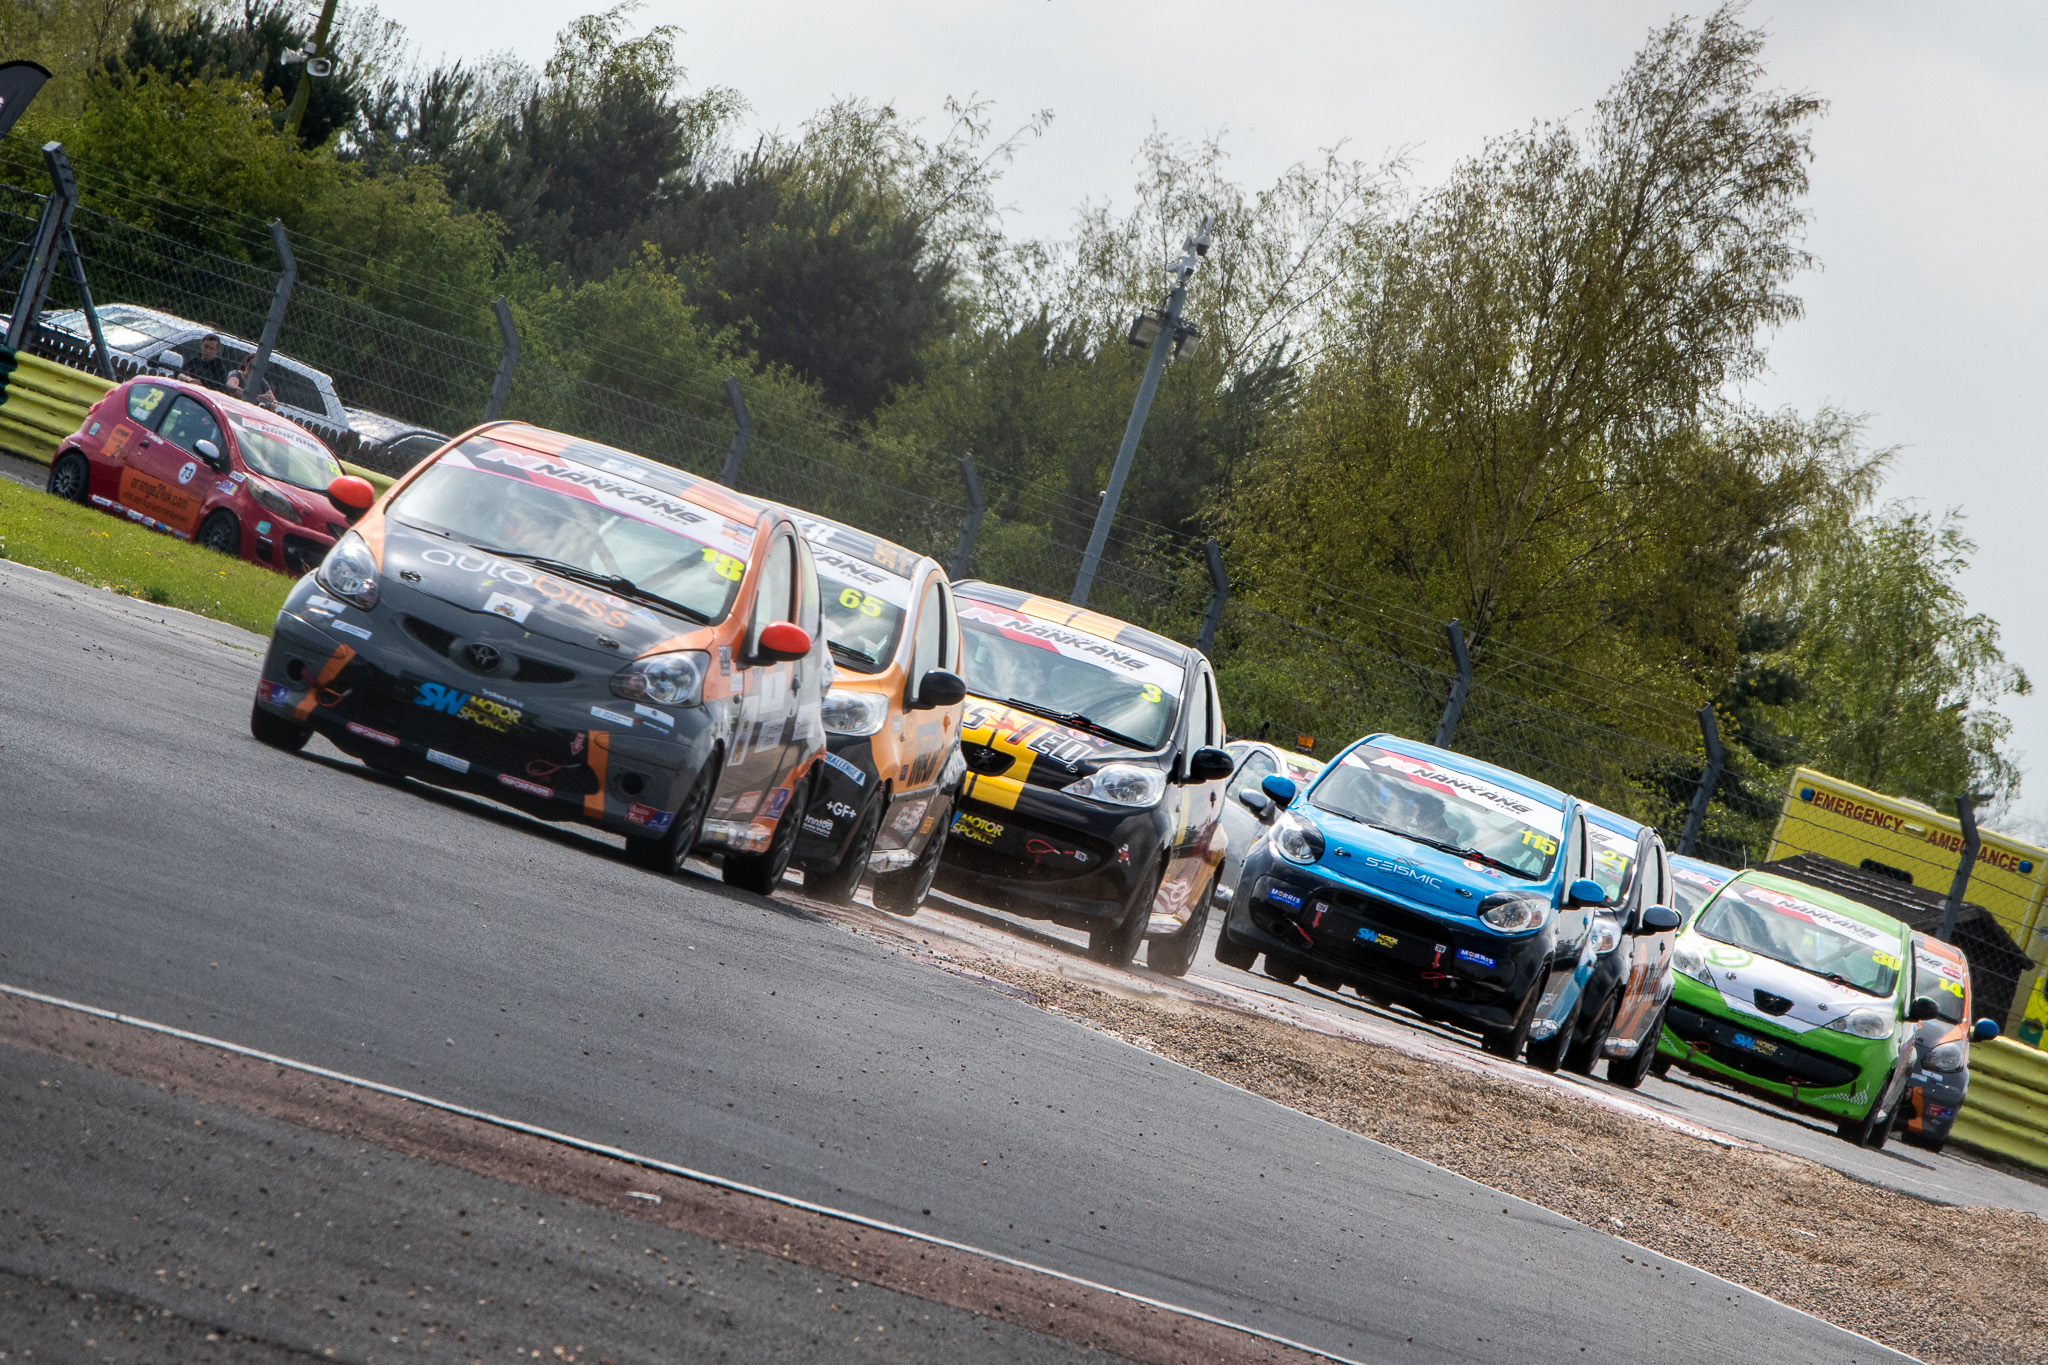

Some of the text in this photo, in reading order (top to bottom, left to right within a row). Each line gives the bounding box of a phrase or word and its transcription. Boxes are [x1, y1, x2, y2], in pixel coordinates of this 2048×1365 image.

[261, 425, 319, 451] NANKANG
[180, 465, 194, 480] 73
[532, 463, 708, 524] NANKANG
[701, 548, 745, 582] 18
[812, 551, 890, 583] ANG
[421, 549, 629, 629] autobliss
[838, 587, 884, 618] 65
[1006, 620, 1150, 670] NANKANG
[413, 682, 471, 716] SW
[1140, 683, 1163, 704] 3
[470, 695, 523, 725] MOTOR
[1411, 769, 1534, 814] NANKANG
[961, 814, 1005, 837] MOTOR
[1814, 791, 2020, 872] EMERGENCY AMBANCE
[1521, 829, 1557, 857] 115
[1365, 857, 1443, 889] SEISMIC
[1600, 850, 1628, 871] 21
[1271, 888, 1301, 904] MORRIS
[1777, 899, 1879, 939] NANKANG
[1356, 927, 1380, 942] SW
[1461, 949, 1494, 965] MORRIS
[1871, 949, 1900, 972] 30
[1938, 976, 1964, 999] 14
[1731, 1033, 1757, 1049] SW
